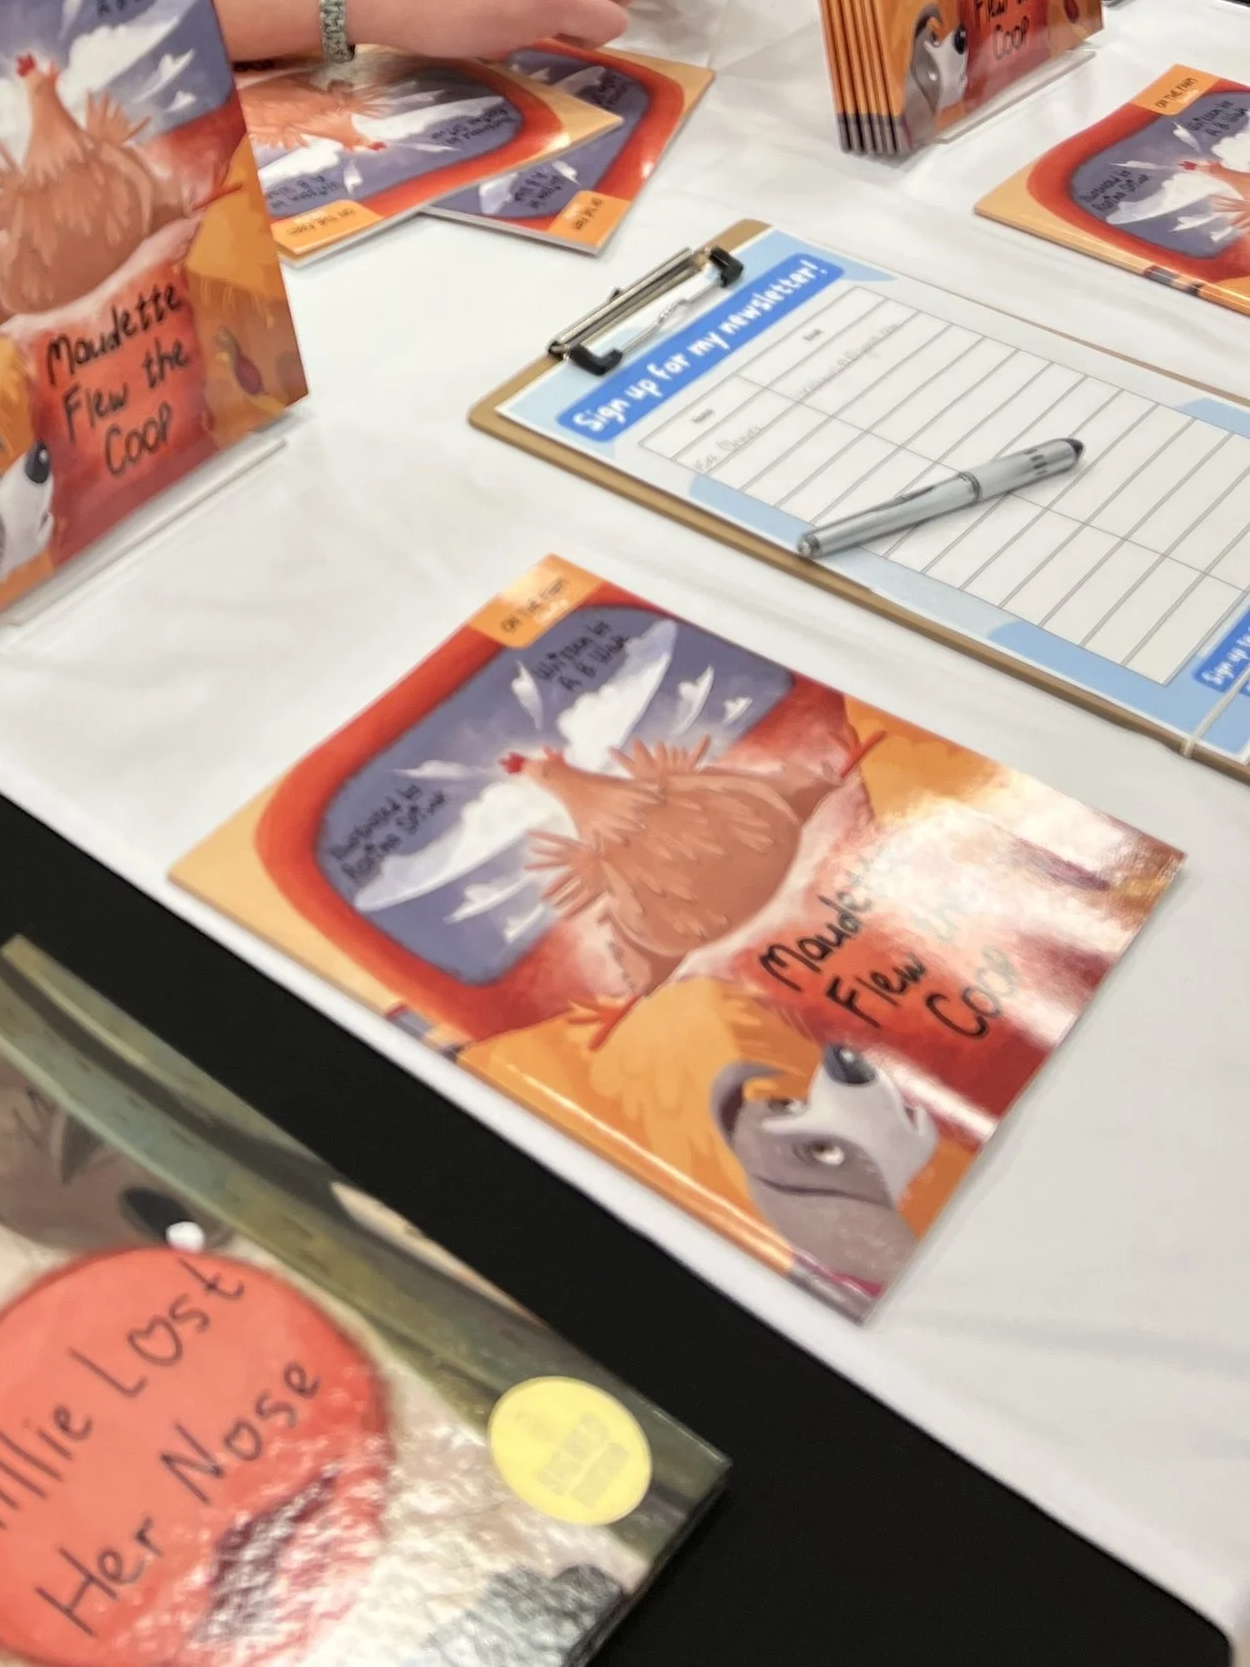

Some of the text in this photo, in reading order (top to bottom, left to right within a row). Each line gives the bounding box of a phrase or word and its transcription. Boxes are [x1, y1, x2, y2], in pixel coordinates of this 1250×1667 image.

[46, 281, 180, 386] Maudette
[572, 259, 829, 433] Sign up for my newsletter!
[63, 337, 189, 446] Flew the
[1202, 661, 1235, 686] Sign
[826, 954, 926, 1030] Flew
[67, 1256, 245, 1398] Lost
[36, 1361, 321, 1638] Her Nose
